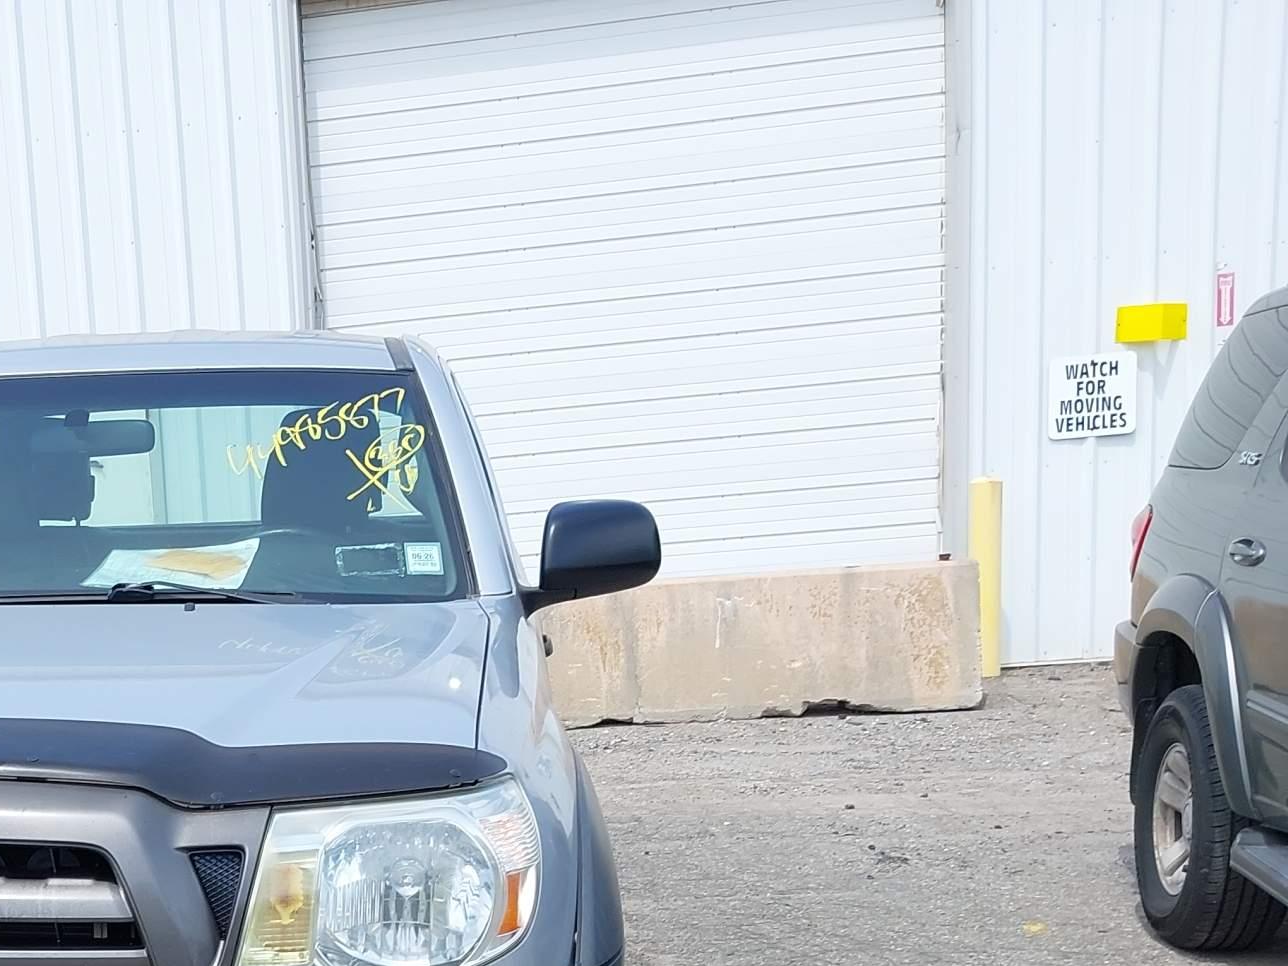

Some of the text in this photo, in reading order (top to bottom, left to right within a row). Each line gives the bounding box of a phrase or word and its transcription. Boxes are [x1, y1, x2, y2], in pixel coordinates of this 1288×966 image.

[1065, 360, 1119, 380] WATCH
[1076, 380, 1106, 396] FOR
[1059, 395, 1123, 415] MOVING
[1055, 412, 1127, 433] VEHICLES
